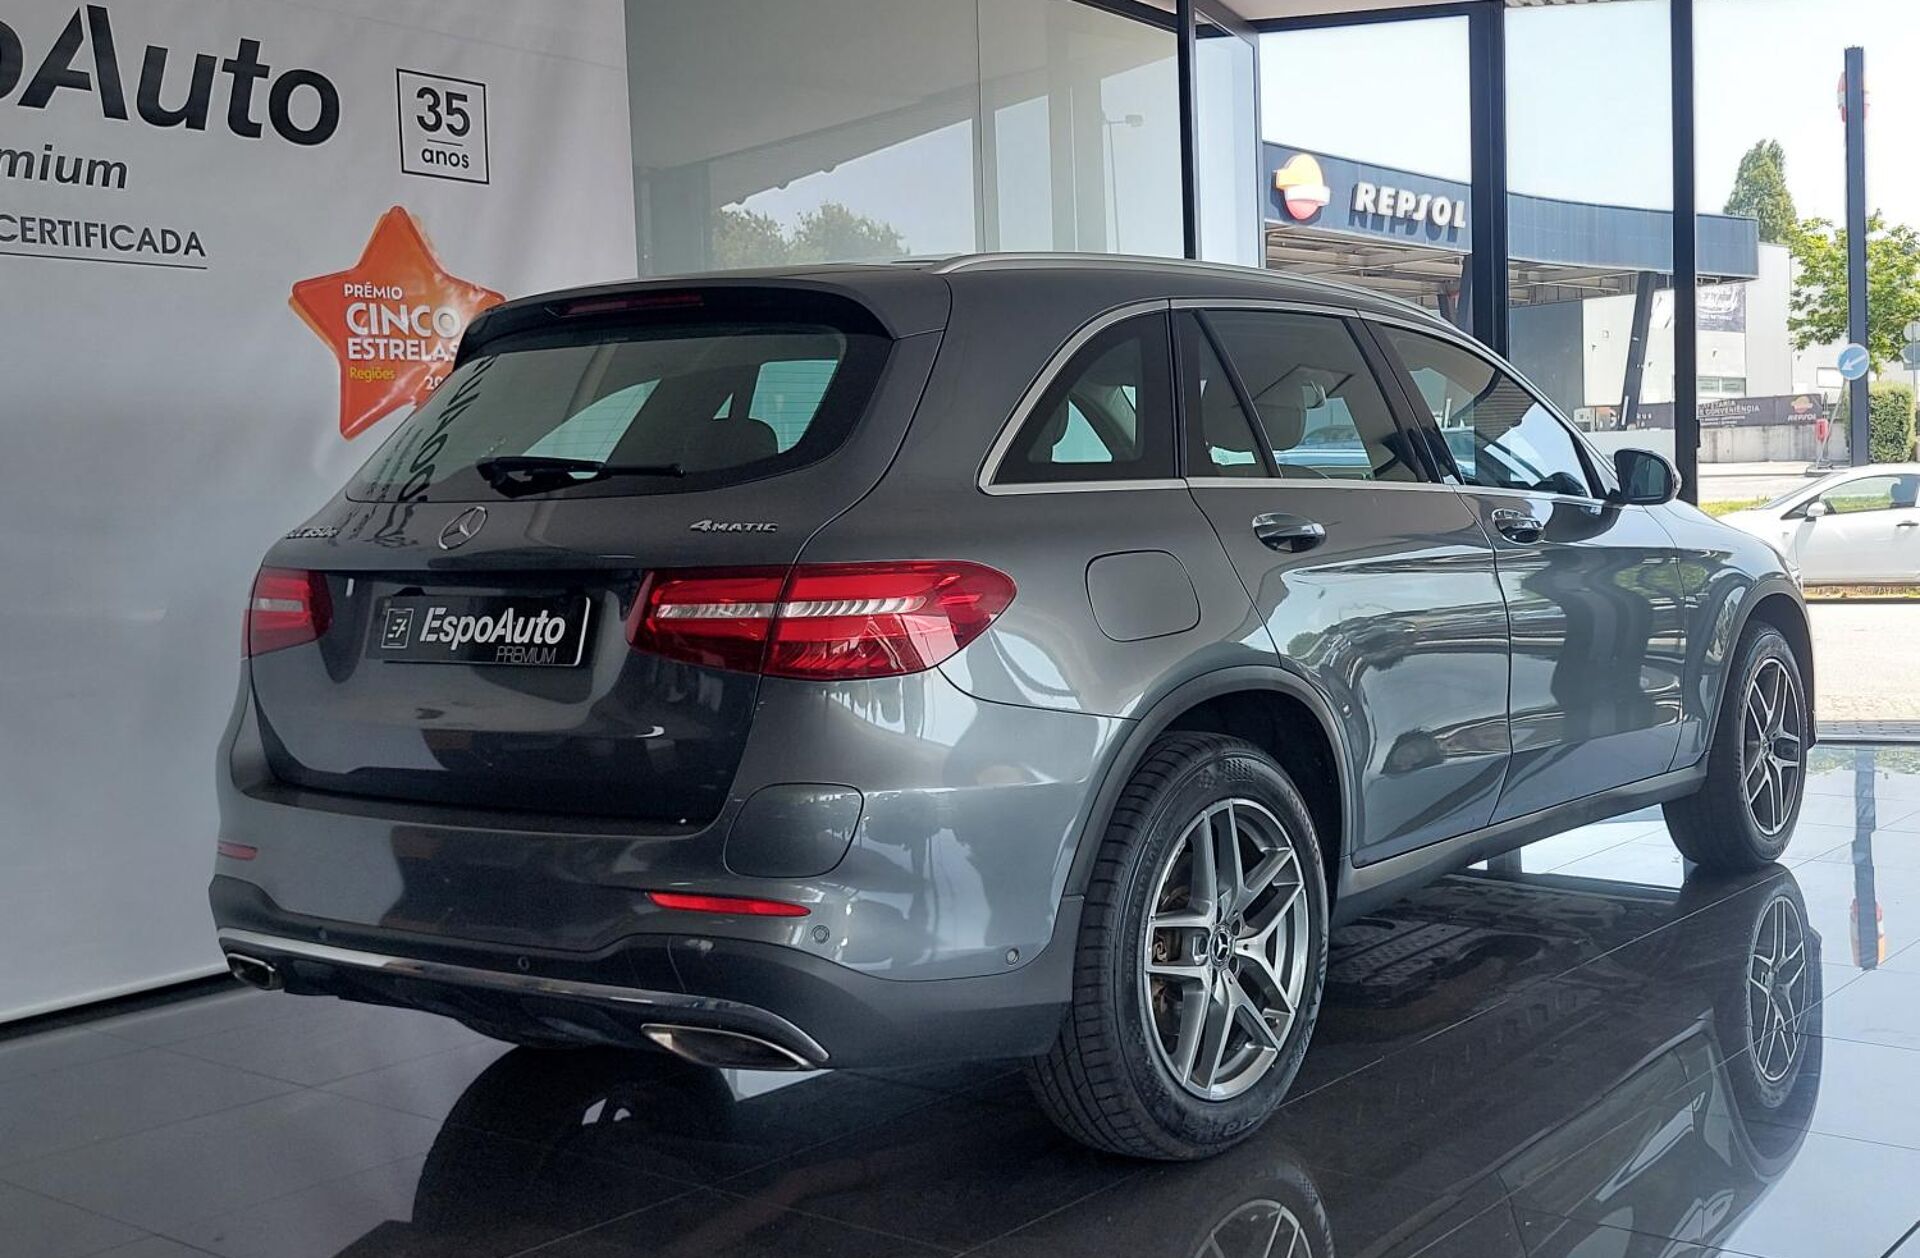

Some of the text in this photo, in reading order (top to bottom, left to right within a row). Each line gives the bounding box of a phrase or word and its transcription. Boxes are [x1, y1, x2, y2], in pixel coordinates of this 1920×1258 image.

[416, 86, 471, 137] 35
[421, 148, 470, 169] anos
[1354, 181, 1466, 229] REPSOL
[0, 214, 206, 257] CERTIFICADA
[344, 281, 403, 300] PRÉMIO
[346, 302, 461, 338] CINCO
[350, 366, 396, 383] Regiões
[690, 519, 779, 532] 4MATIC
[419, 606, 566, 651] EspoAuto
[495, 645, 557, 664] PREMIUM
